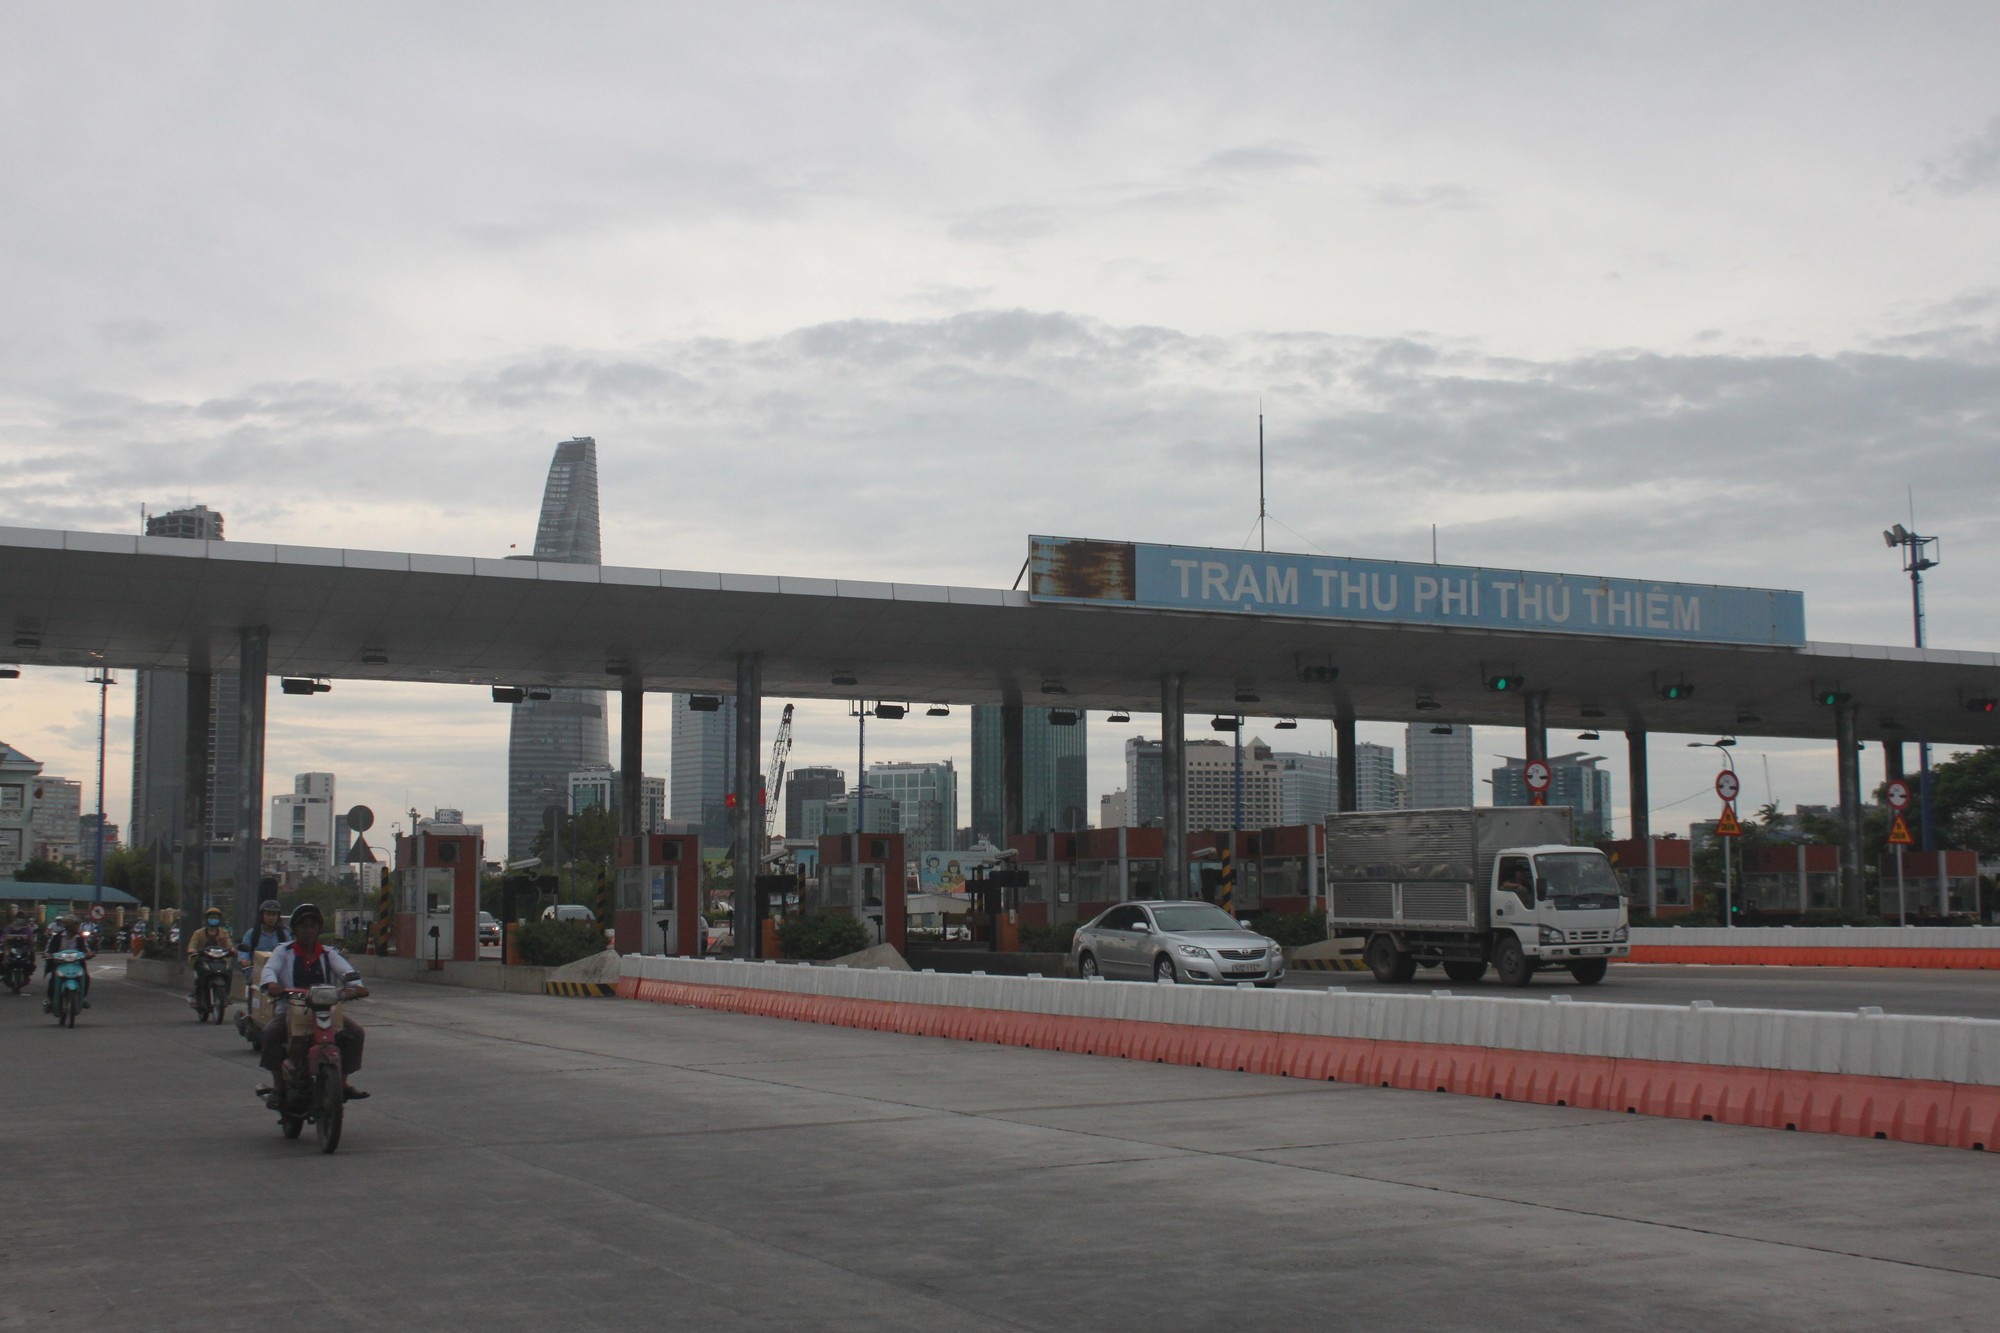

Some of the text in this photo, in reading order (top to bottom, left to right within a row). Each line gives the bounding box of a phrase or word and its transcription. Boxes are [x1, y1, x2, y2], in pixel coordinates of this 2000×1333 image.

[1171, 559, 1700, 632] TRẠM THU PHÍ THỦ THIÊM
